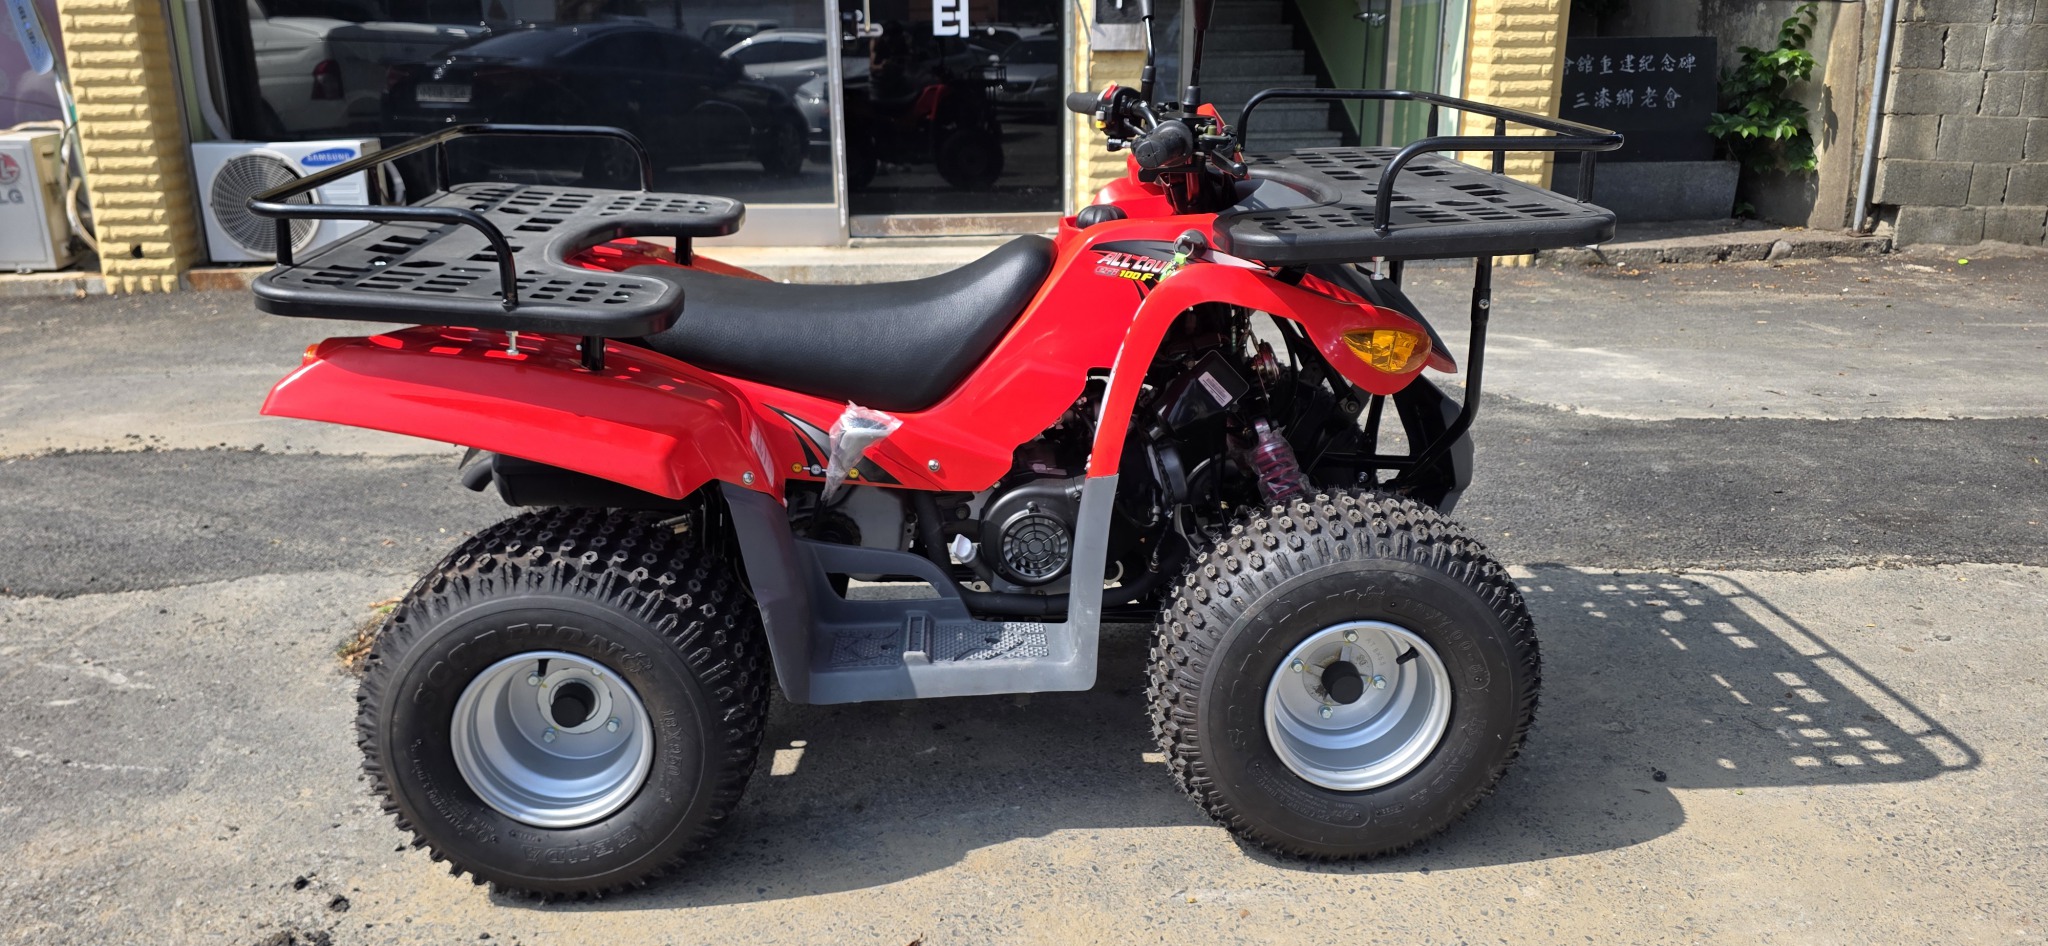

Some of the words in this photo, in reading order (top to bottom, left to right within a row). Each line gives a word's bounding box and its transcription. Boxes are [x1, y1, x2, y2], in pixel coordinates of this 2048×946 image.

[307, 152, 350, 161] SAMSUNG
[1119, 270, 1141, 280] 100
[1140, 273, 1155, 281] F
